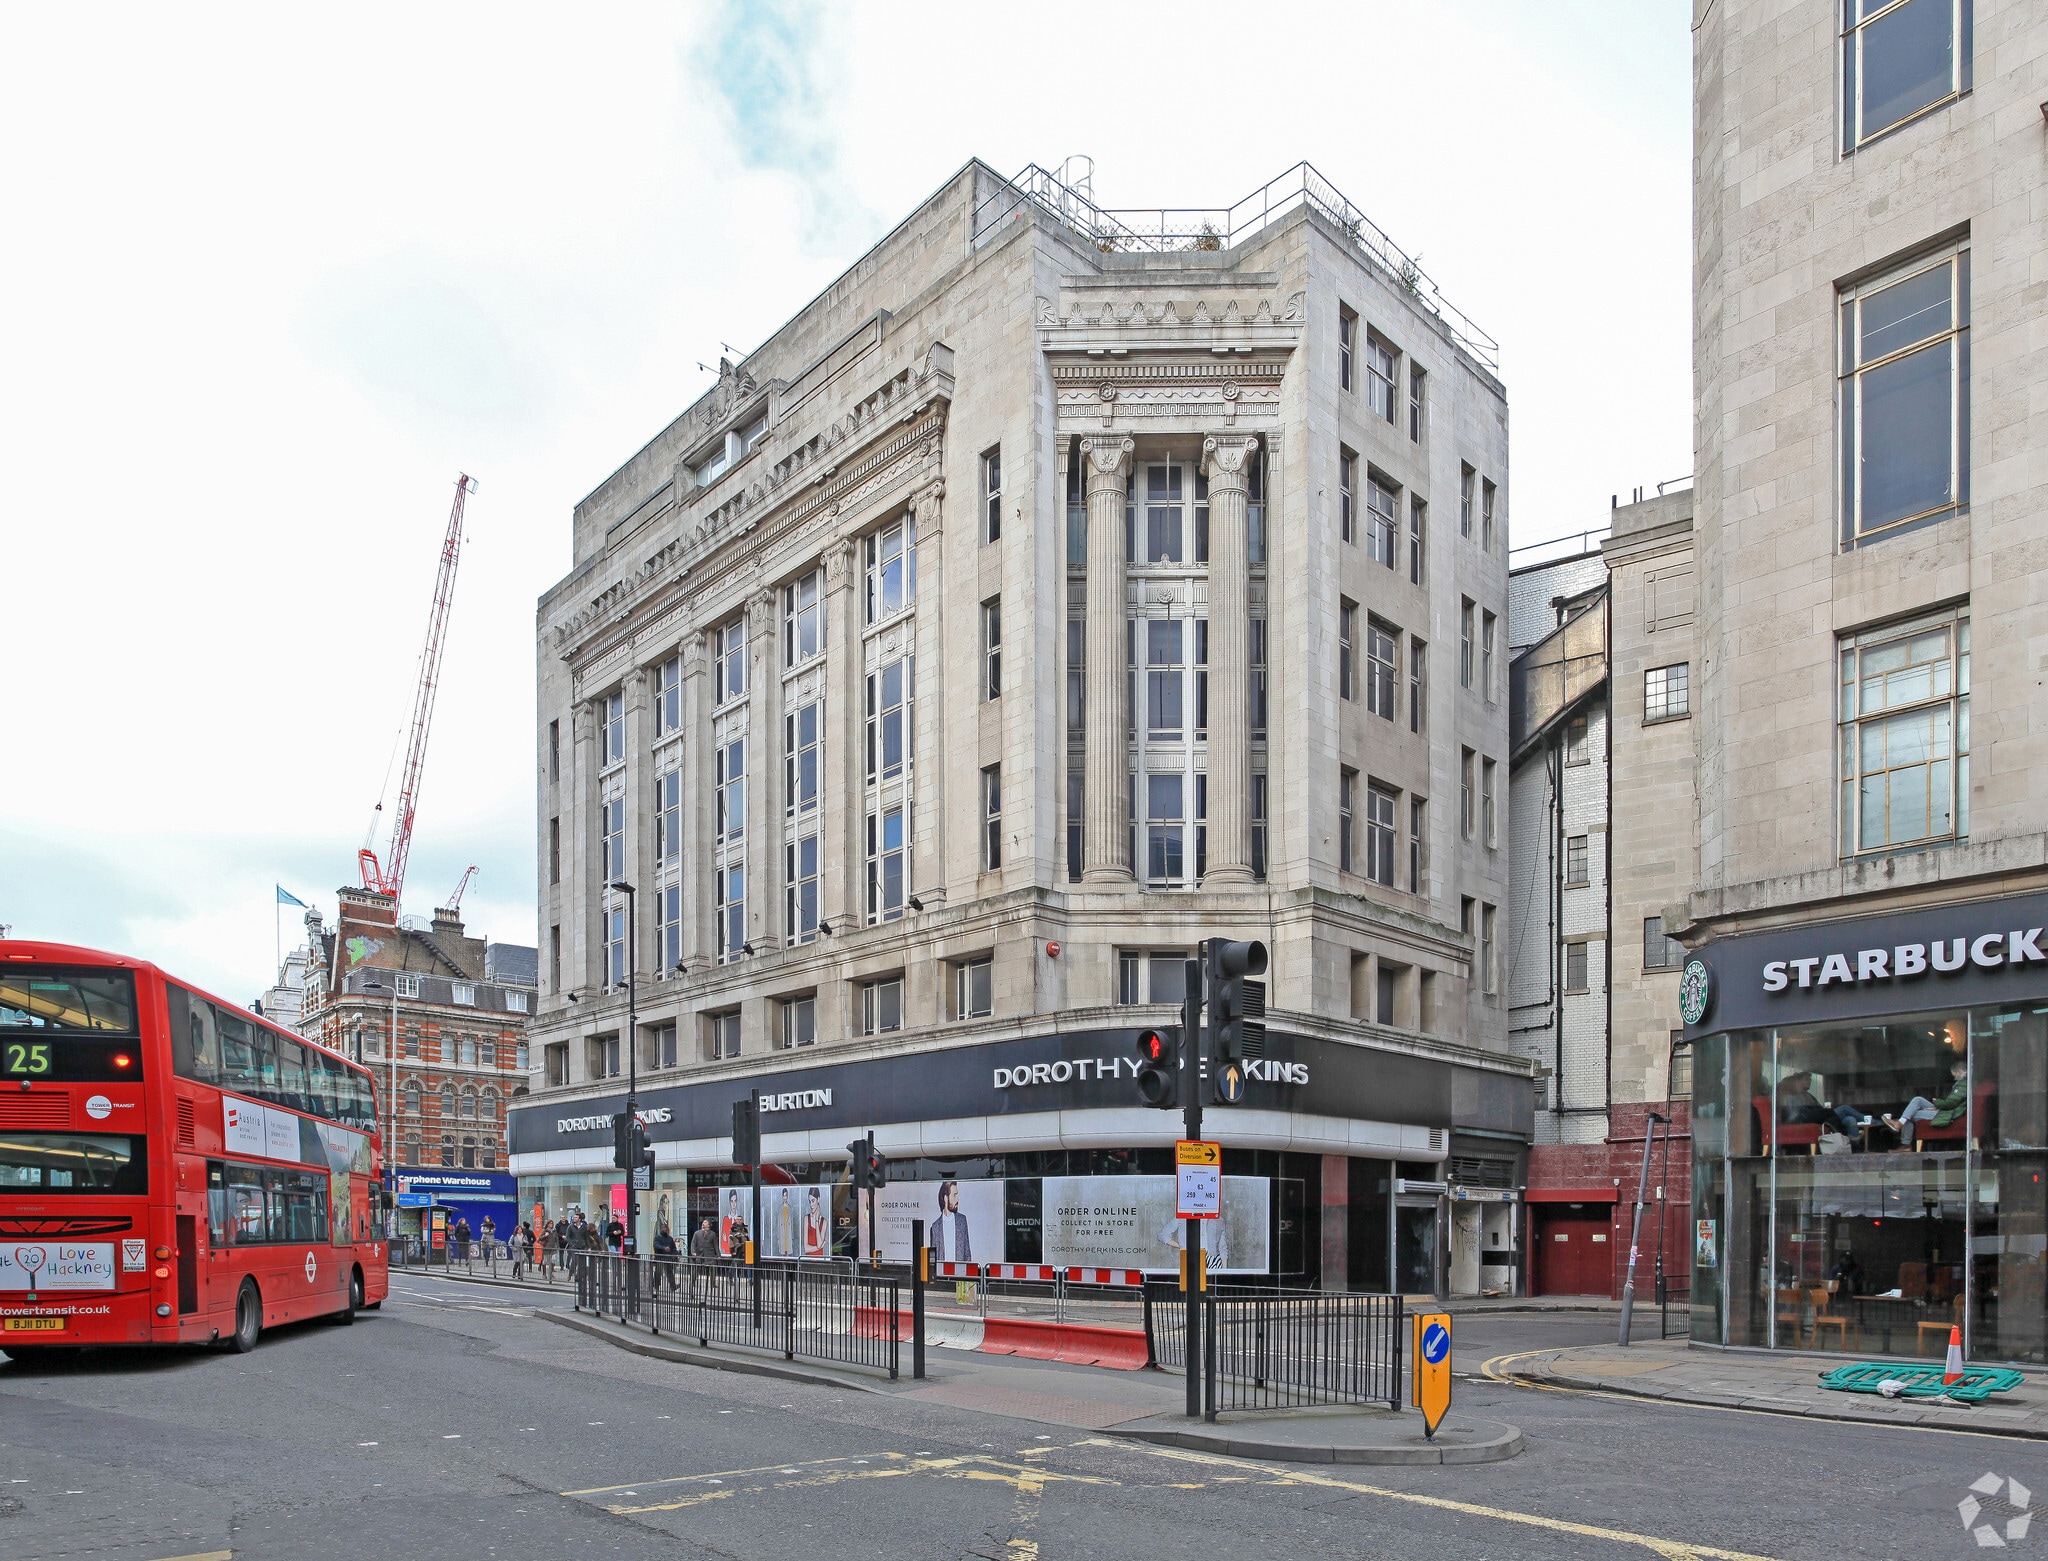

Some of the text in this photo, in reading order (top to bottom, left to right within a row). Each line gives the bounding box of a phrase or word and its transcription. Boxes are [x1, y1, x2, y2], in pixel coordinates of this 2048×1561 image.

[1763, 928, 2047, 992] STARBUCK
[8, 1044, 49, 1073] 25
[994, 1056, 1143, 1089] DOROTHY
[759, 1088, 832, 1113] BURTON
[239, 1112, 261, 1127] Austria
[557, 1114, 615, 1133] DOROTHY
[397, 1175, 491, 1186] Carphone Warehouse
[881, 1201, 899, 1209] ORDER
[1057, 1207, 1138, 1216] ORDER ONLINE
[839, 1217, 851, 1226] DP
[1007, 1218, 1042, 1226] BURTON
[1060, 1219, 1135, 1227] COLLECT IN STORE
[59, 1246, 96, 1261] Love
[1051, 1246, 1147, 1255] DOROTHYPERKINS.COM
[24, 1254, 40, 1264] 20
[47, 1262, 112, 1279] Hackney
[0, 1305, 111, 1316] towertransit.co.uk
[35, 1319, 56, 1329] DTU
